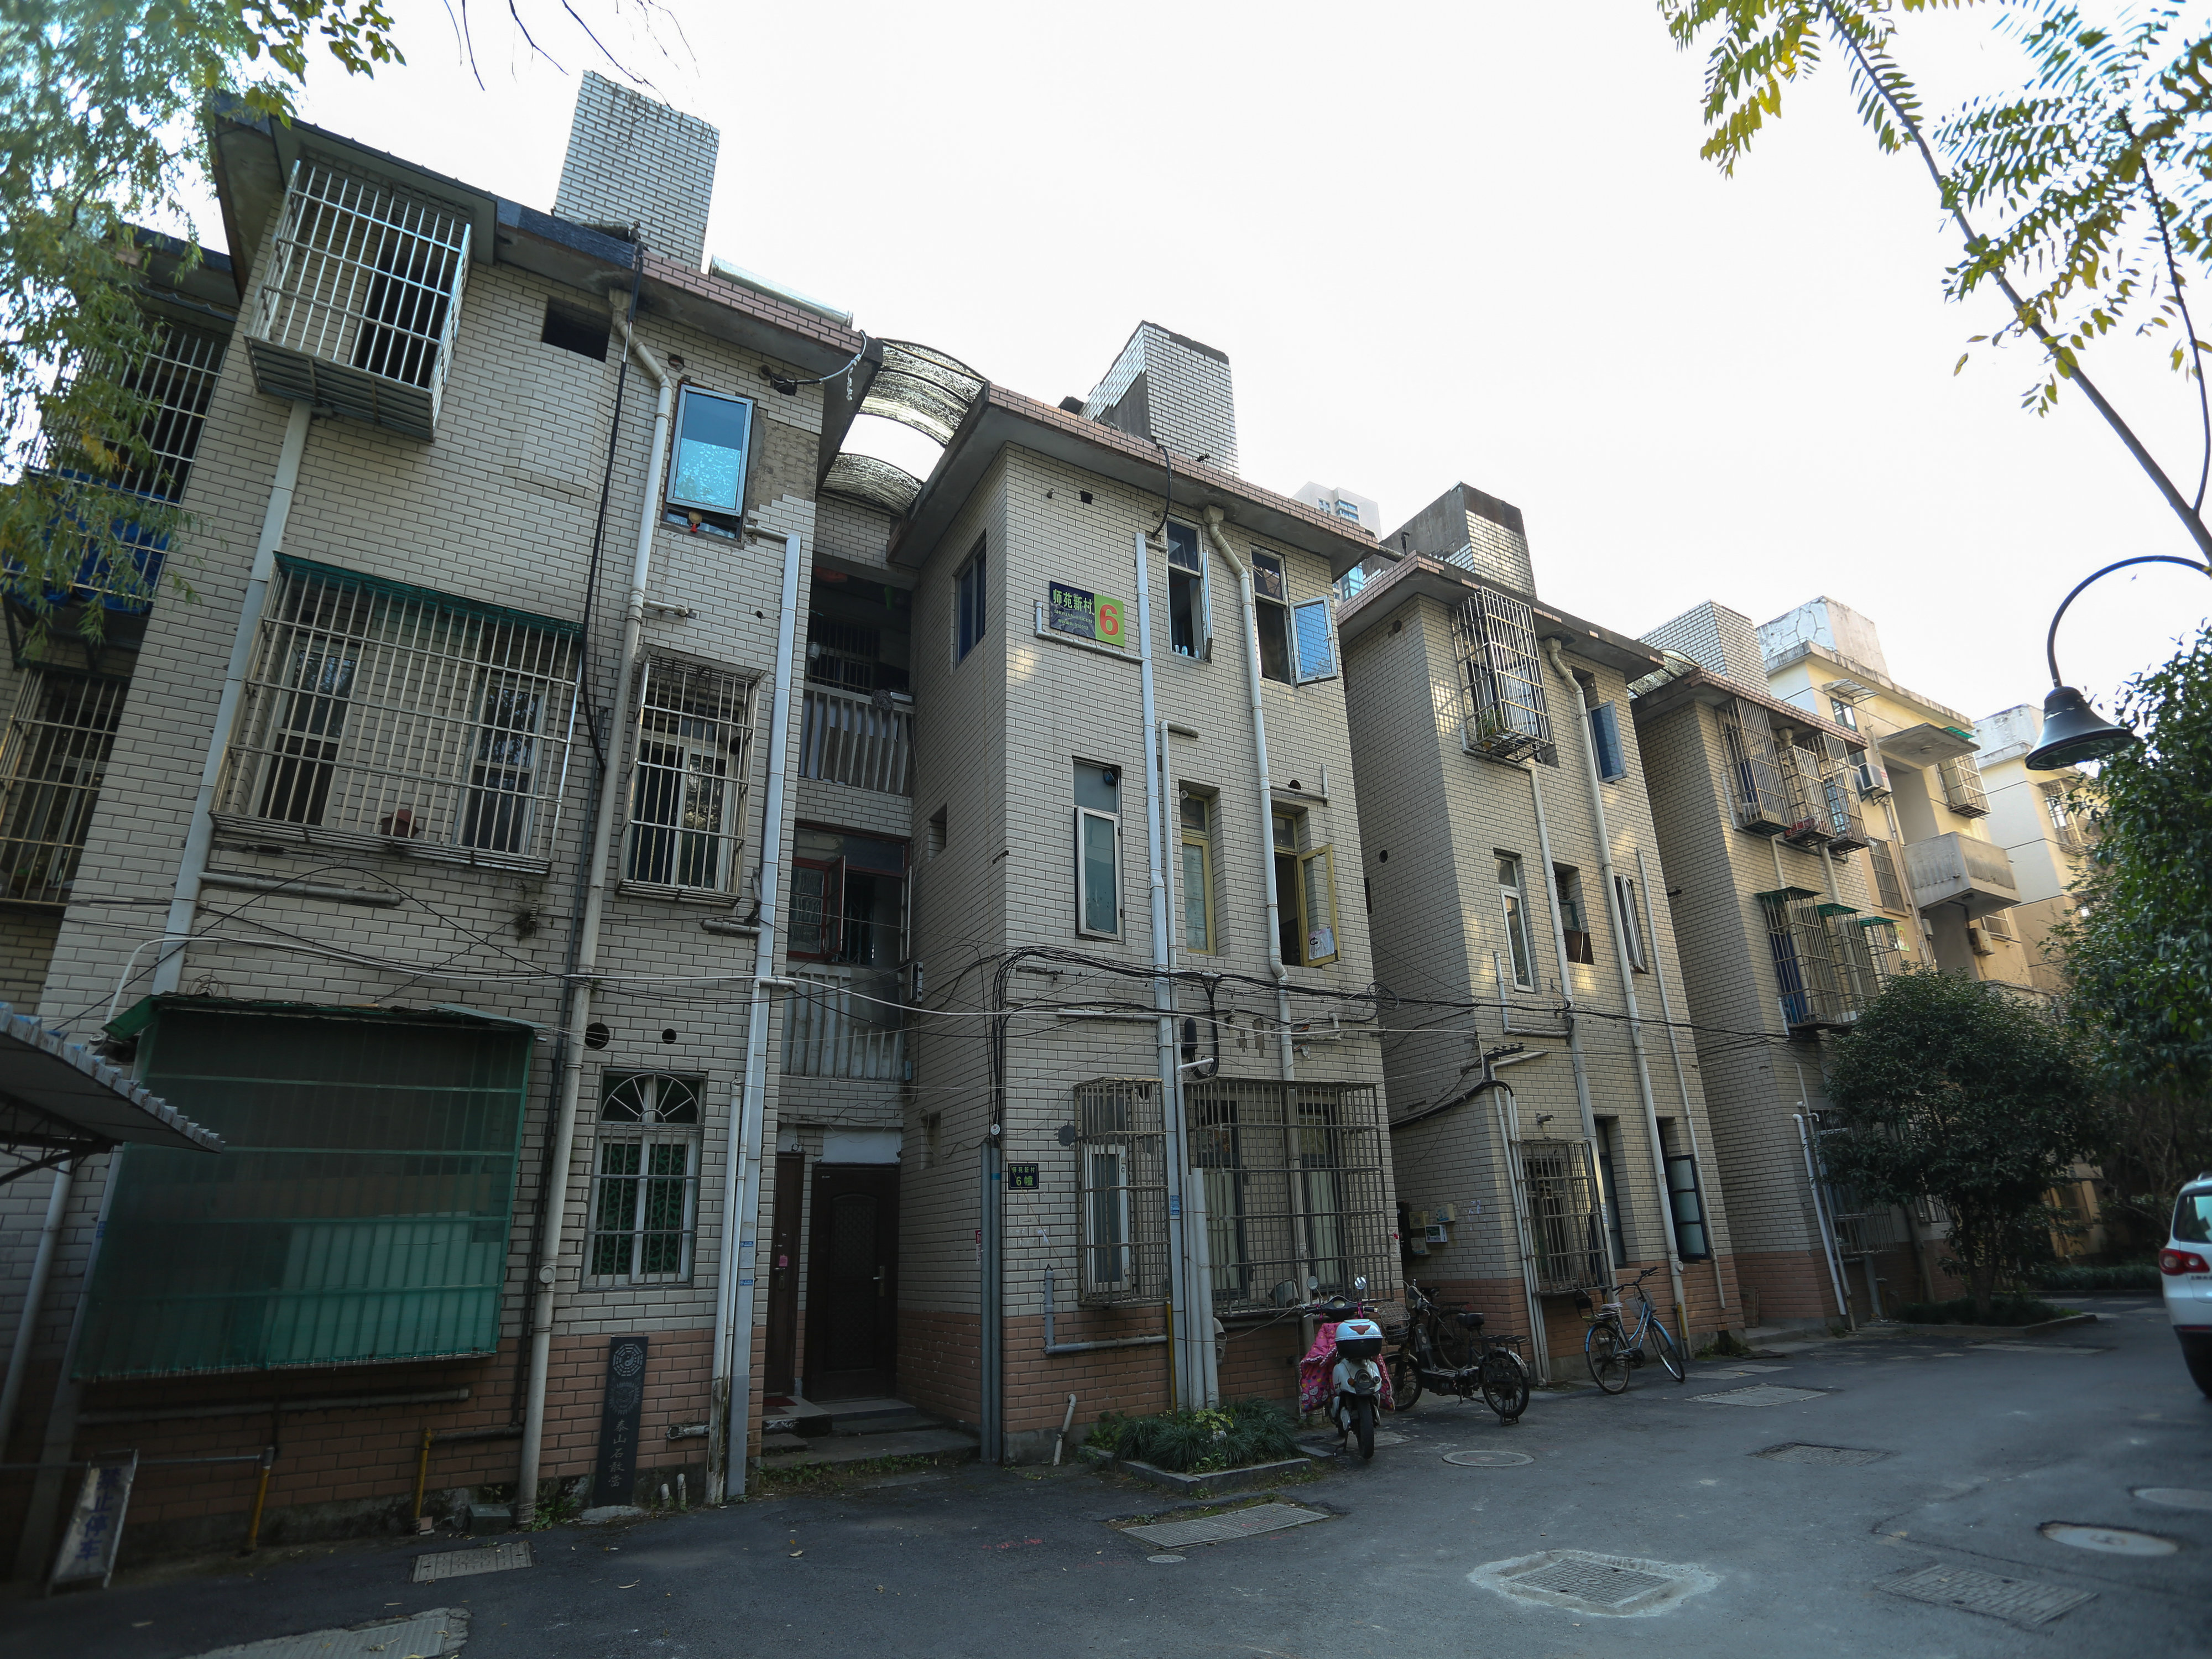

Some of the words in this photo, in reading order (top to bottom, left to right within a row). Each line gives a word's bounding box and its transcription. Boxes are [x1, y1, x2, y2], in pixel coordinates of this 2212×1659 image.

[1053, 588, 1092, 614] 师苑新村
[1100, 604, 1118, 635] 6
